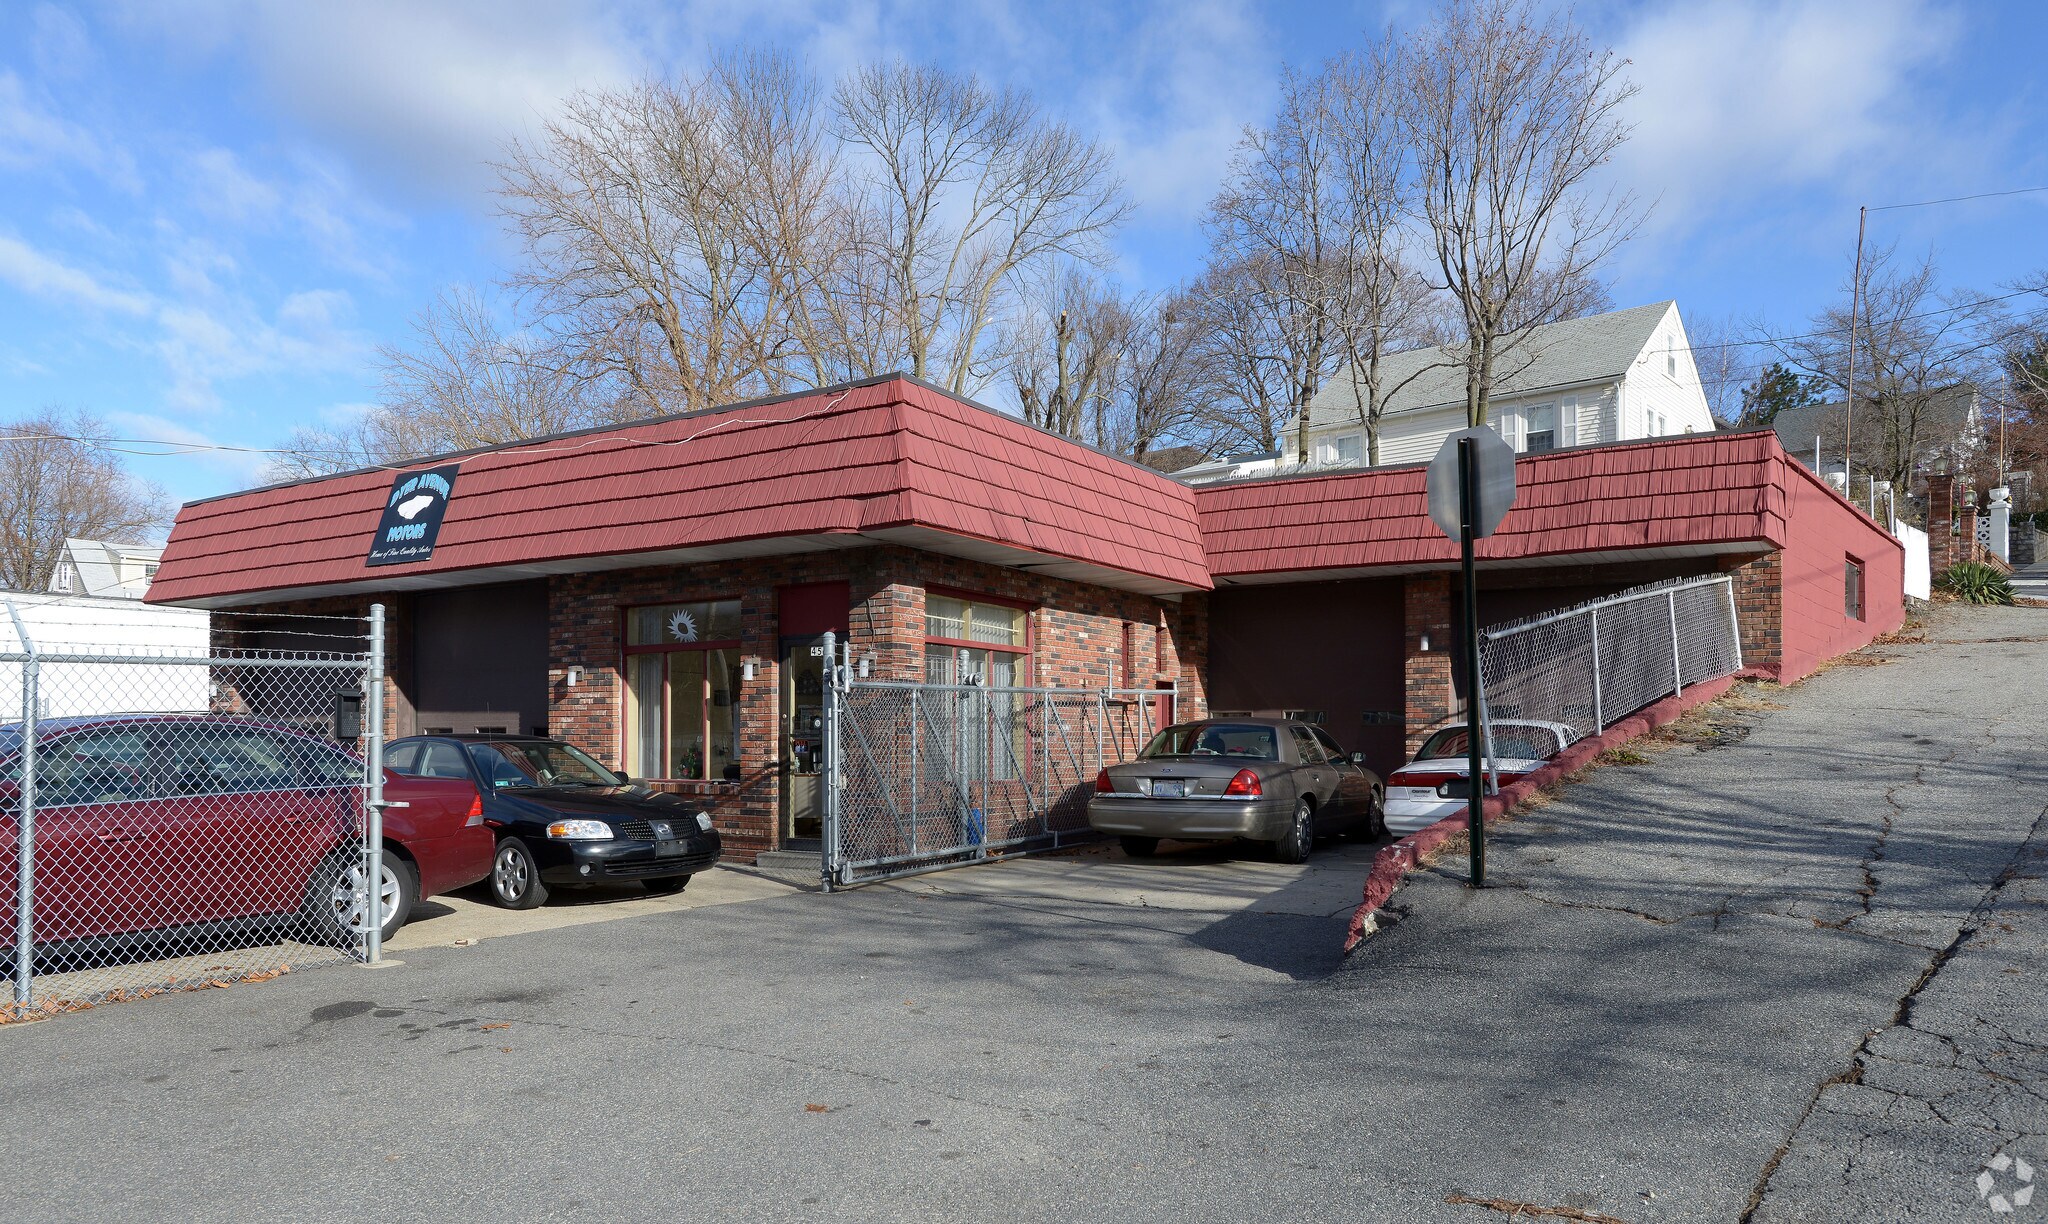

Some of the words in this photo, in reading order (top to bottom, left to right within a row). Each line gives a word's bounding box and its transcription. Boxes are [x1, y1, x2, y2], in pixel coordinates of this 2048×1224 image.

[390, 476, 419, 508] DYER
[417, 473, 450, 501] AVENUE
[386, 522, 428, 543] MOTORS
[383, 549, 390, 559] of
